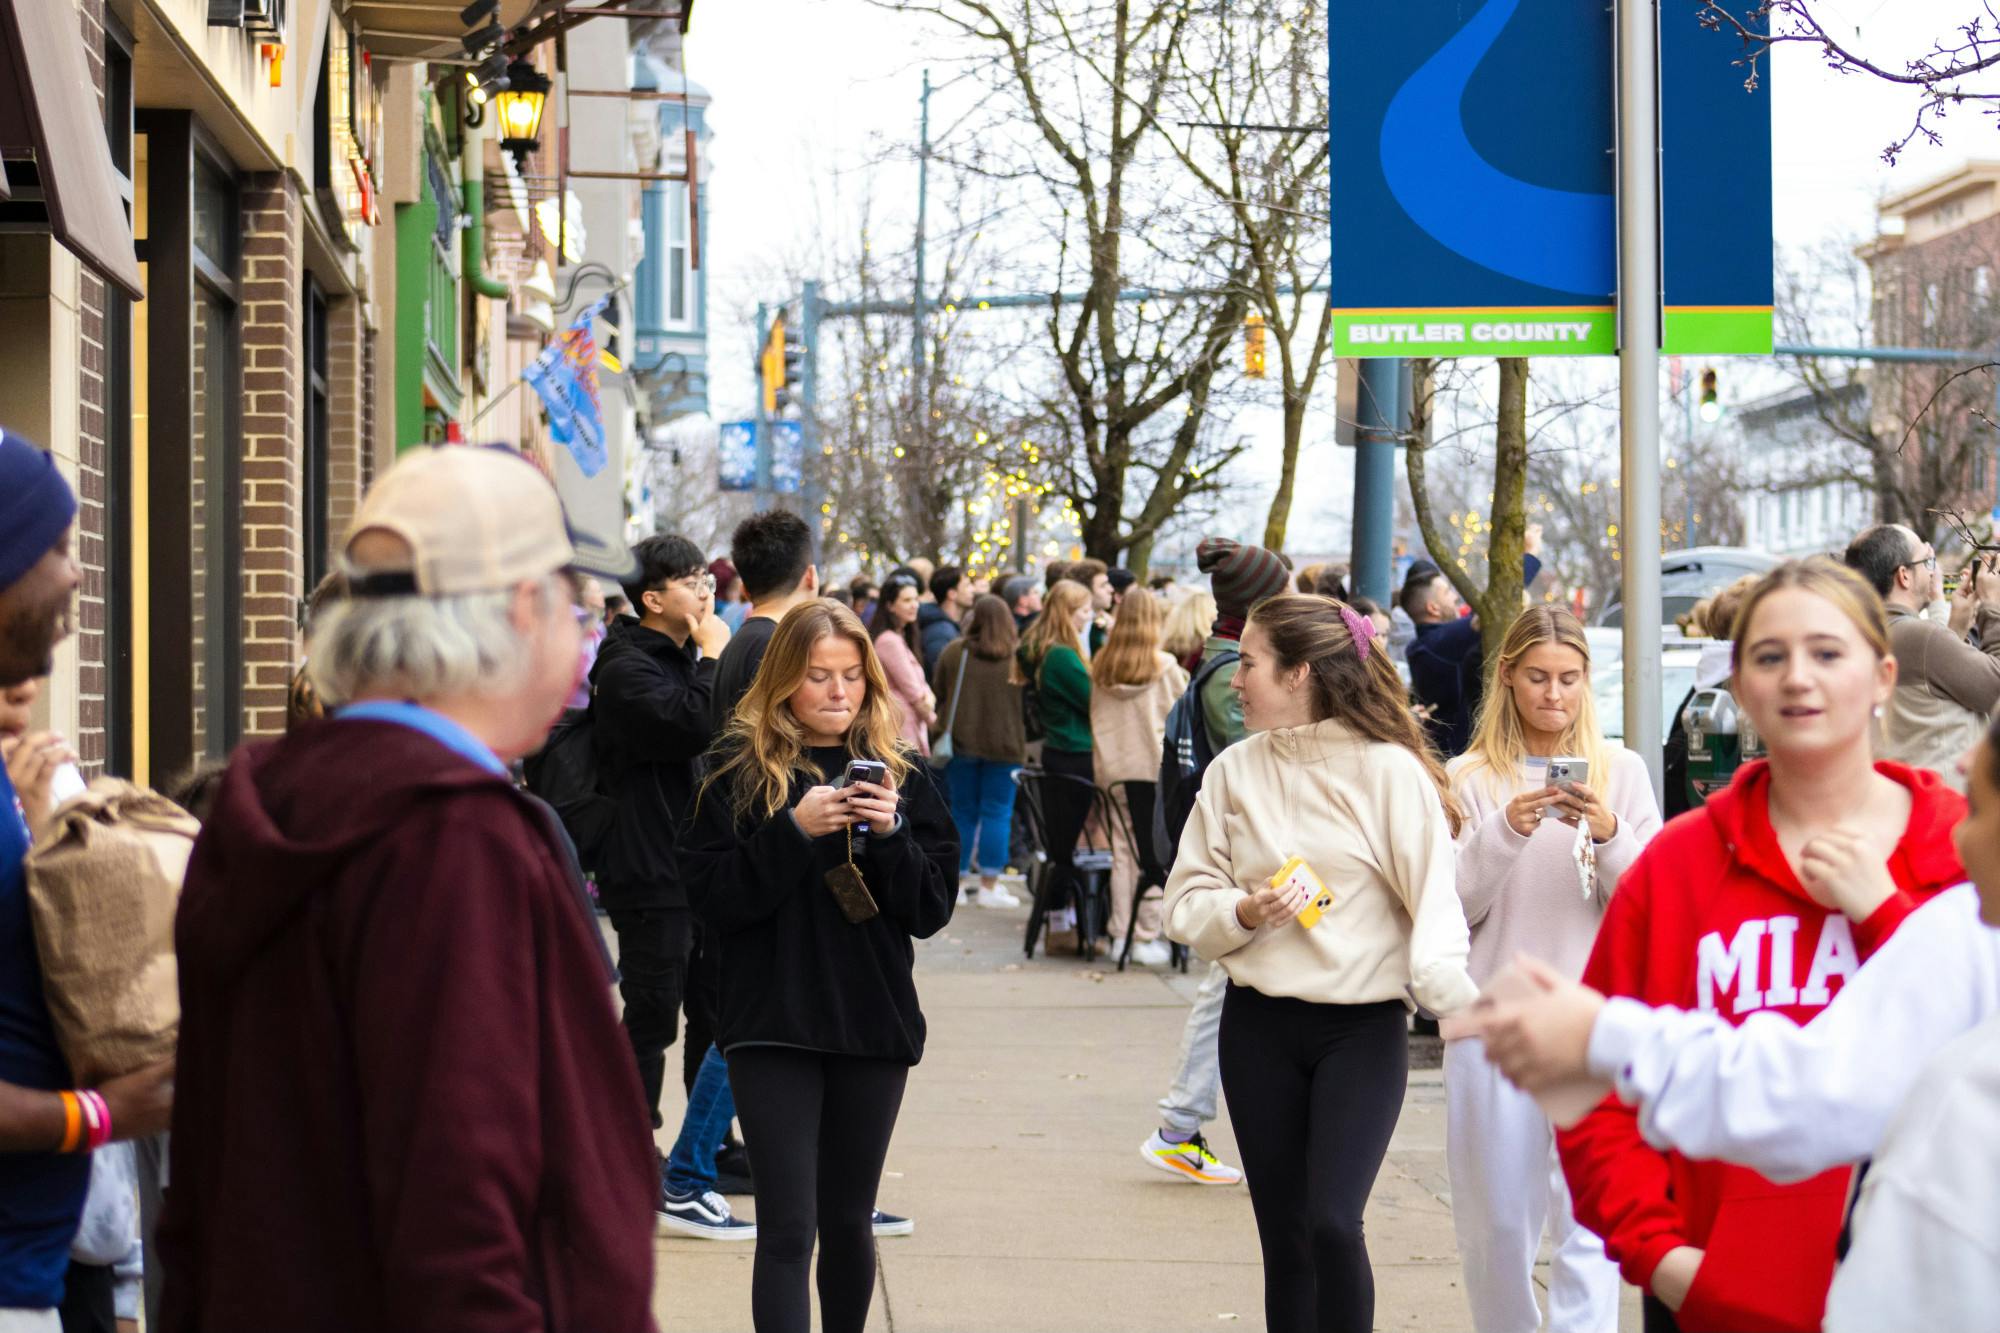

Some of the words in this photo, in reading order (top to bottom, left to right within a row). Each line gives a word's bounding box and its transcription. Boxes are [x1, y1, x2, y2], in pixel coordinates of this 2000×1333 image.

[1349, 323, 1465, 343] BUTLER
[1471, 322, 1592, 342] COUNTY
[1697, 913, 1861, 1015] MIA
